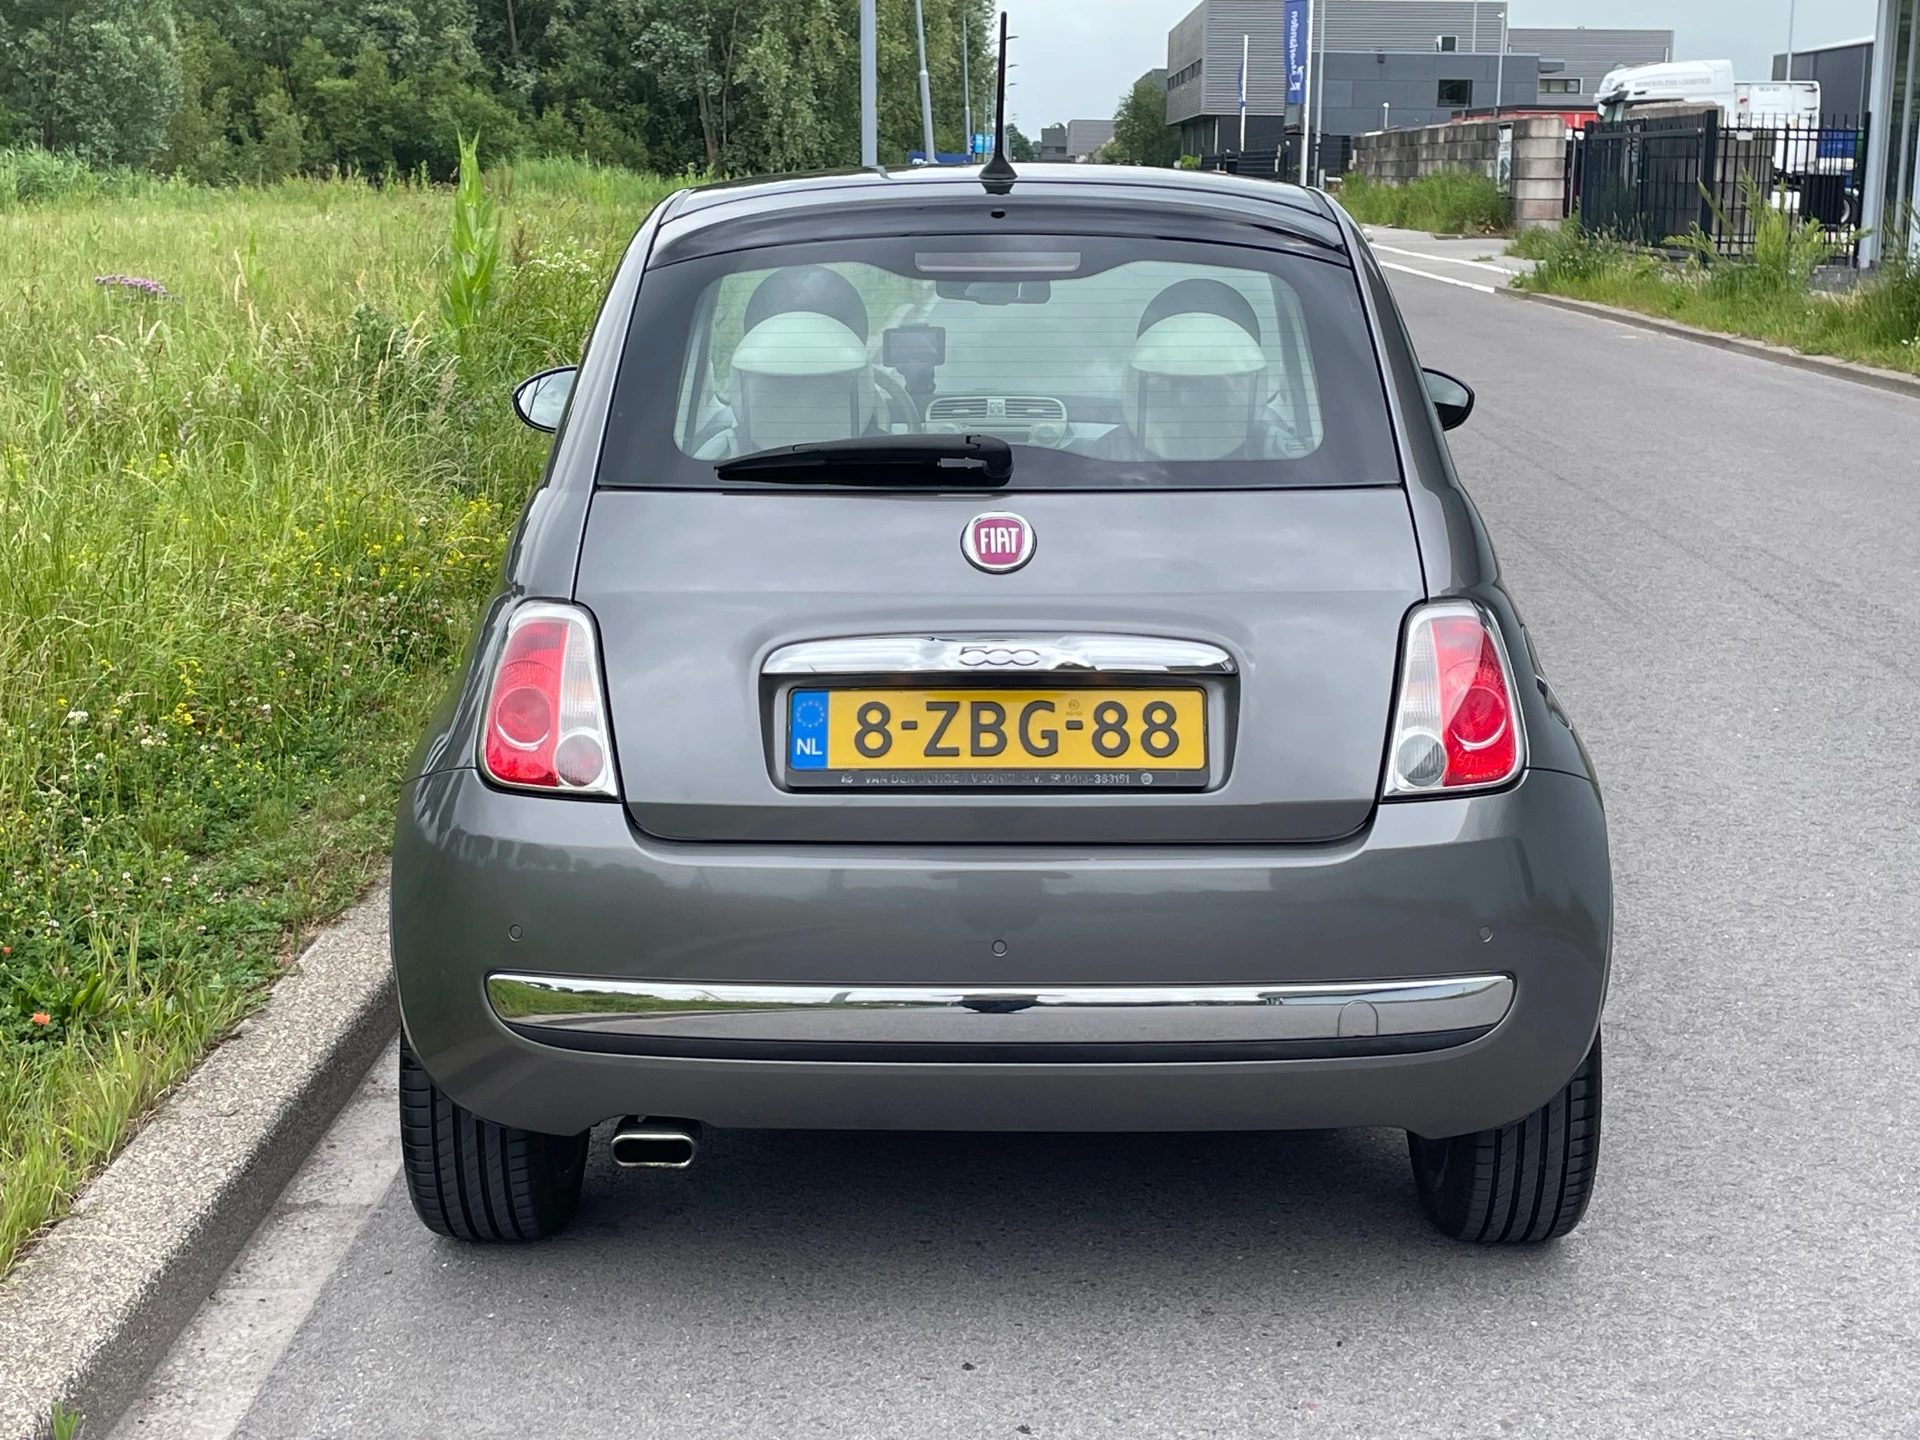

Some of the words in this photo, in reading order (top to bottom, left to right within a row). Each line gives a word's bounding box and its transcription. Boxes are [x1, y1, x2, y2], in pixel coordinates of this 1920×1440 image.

[980, 527, 1019, 554] FIAT
[959, 645, 1040, 666] 500
[854, 701, 1180, 759] 8-ZBG-88
[797, 738, 823, 755] NL
